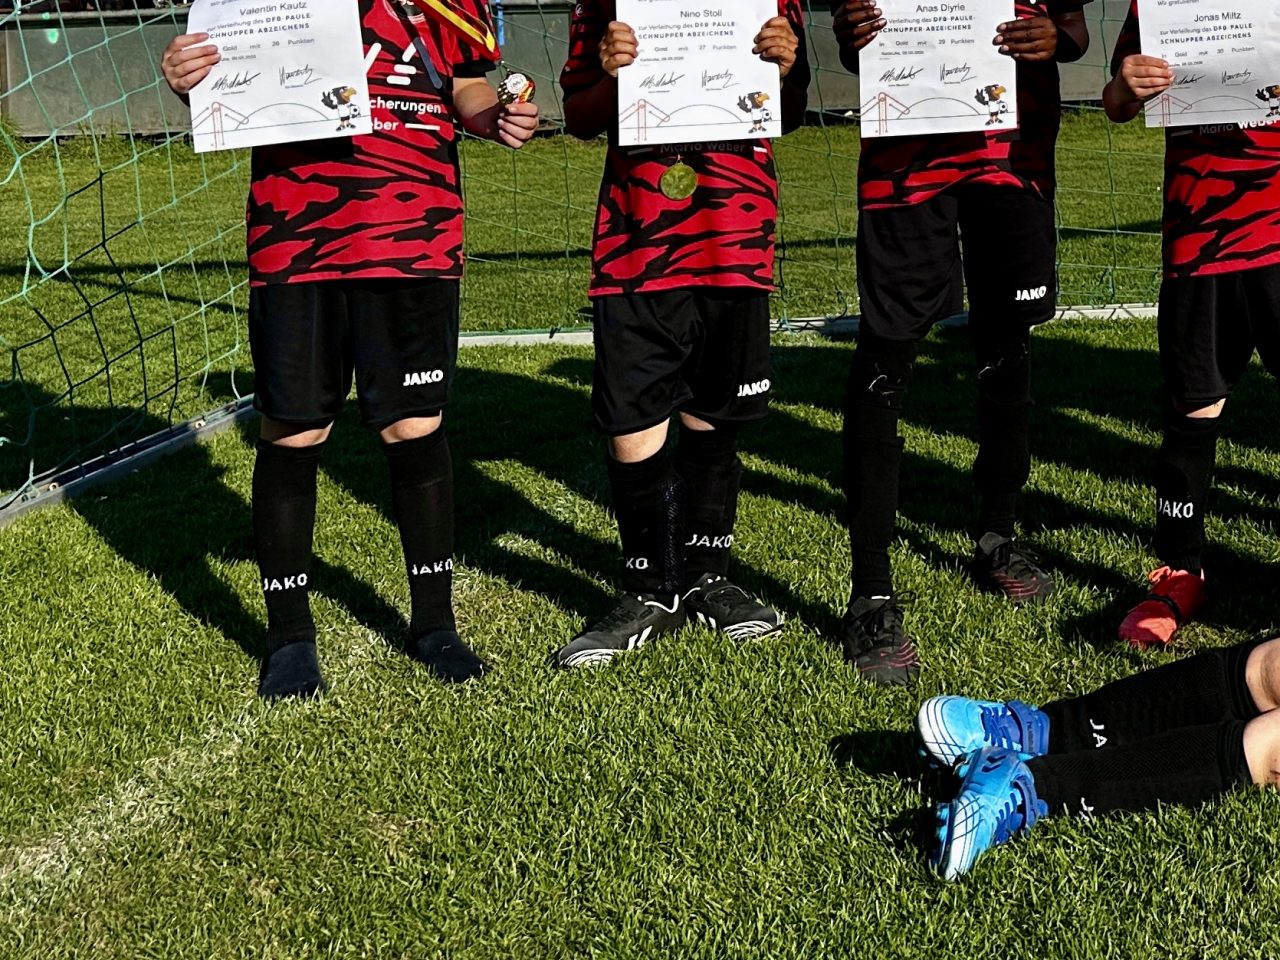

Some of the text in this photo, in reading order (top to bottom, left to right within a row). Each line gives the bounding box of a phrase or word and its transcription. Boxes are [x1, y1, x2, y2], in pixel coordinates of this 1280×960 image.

[240, 0, 308, 16] Valentin Kautz
[680, 9, 722, 18] Nino Stoll
[916, 4, 938, 12] Anas
[1194, 11, 1242, 23] Jonas Miltz
[209, 23, 310, 39] CHNUPPER-ABZEICHENS
[370, 96, 441, 114] cherungen
[373, 119, 399, 131] eber
[1199, 123, 1234, 135] Mario
[660, 140, 746, 153] Mario Weber
[1015, 285, 1047, 301] JAKO
[403, 369, 443, 387] JAKO
[737, 379, 770, 397] JAKO
[1157, 497, 1194, 518] JAKO
[685, 533, 734, 548] JAKO
[412, 558, 453, 576] JAKO
[625, 557, 649, 570] KO
[264, 573, 308, 591] JAKO
[1089, 718, 1108, 748] JA
